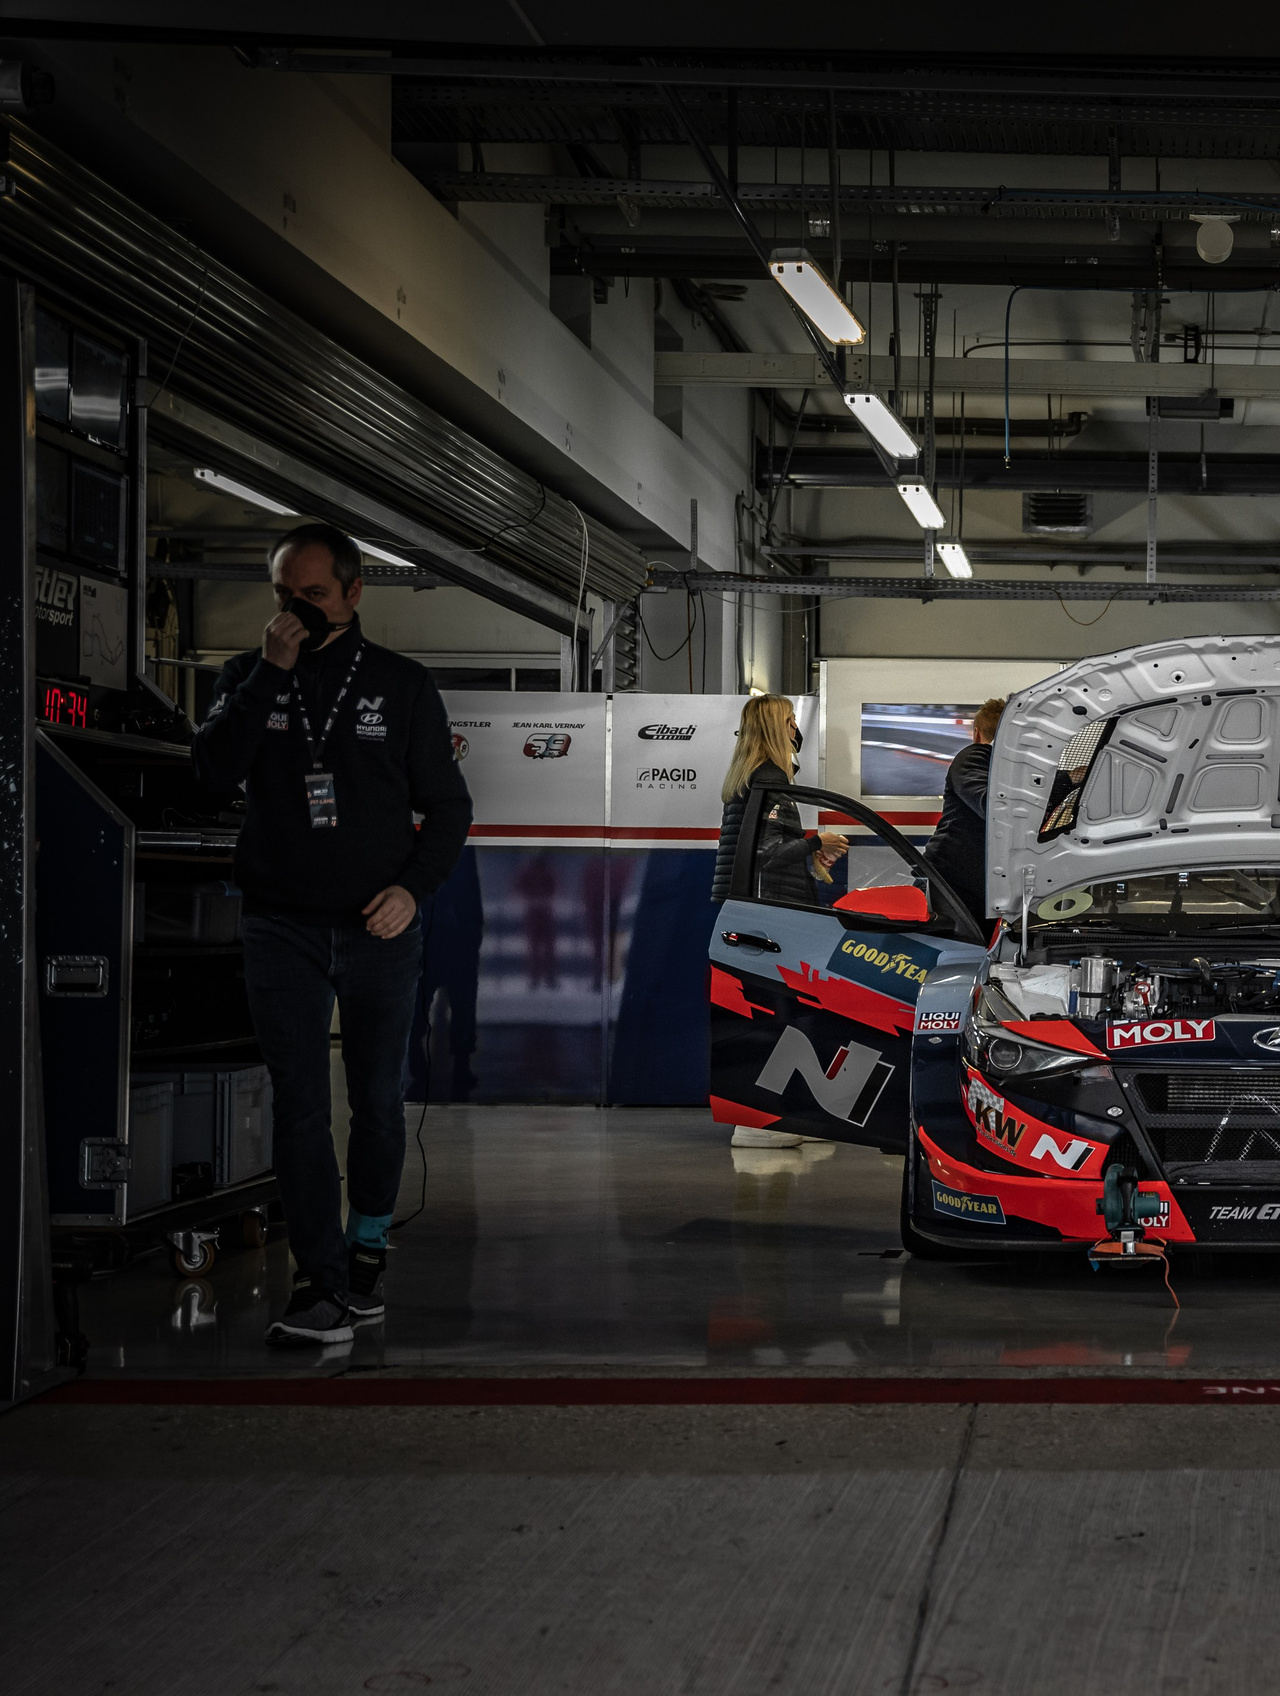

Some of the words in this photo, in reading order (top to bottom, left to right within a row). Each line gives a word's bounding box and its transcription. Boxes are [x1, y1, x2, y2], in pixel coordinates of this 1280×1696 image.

[638, 724, 697, 741] Eibach
[652, 769, 697, 782] PAGID
[920, 1012, 961, 1021] LIQUI
[918, 1020, 960, 1030] MOLY
[1113, 1020, 1217, 1046] MOLY
[975, 1096, 1028, 1151] KW
[936, 1191, 997, 1214] GOODYEAR
[1208, 1206, 1257, 1220] TEAM
